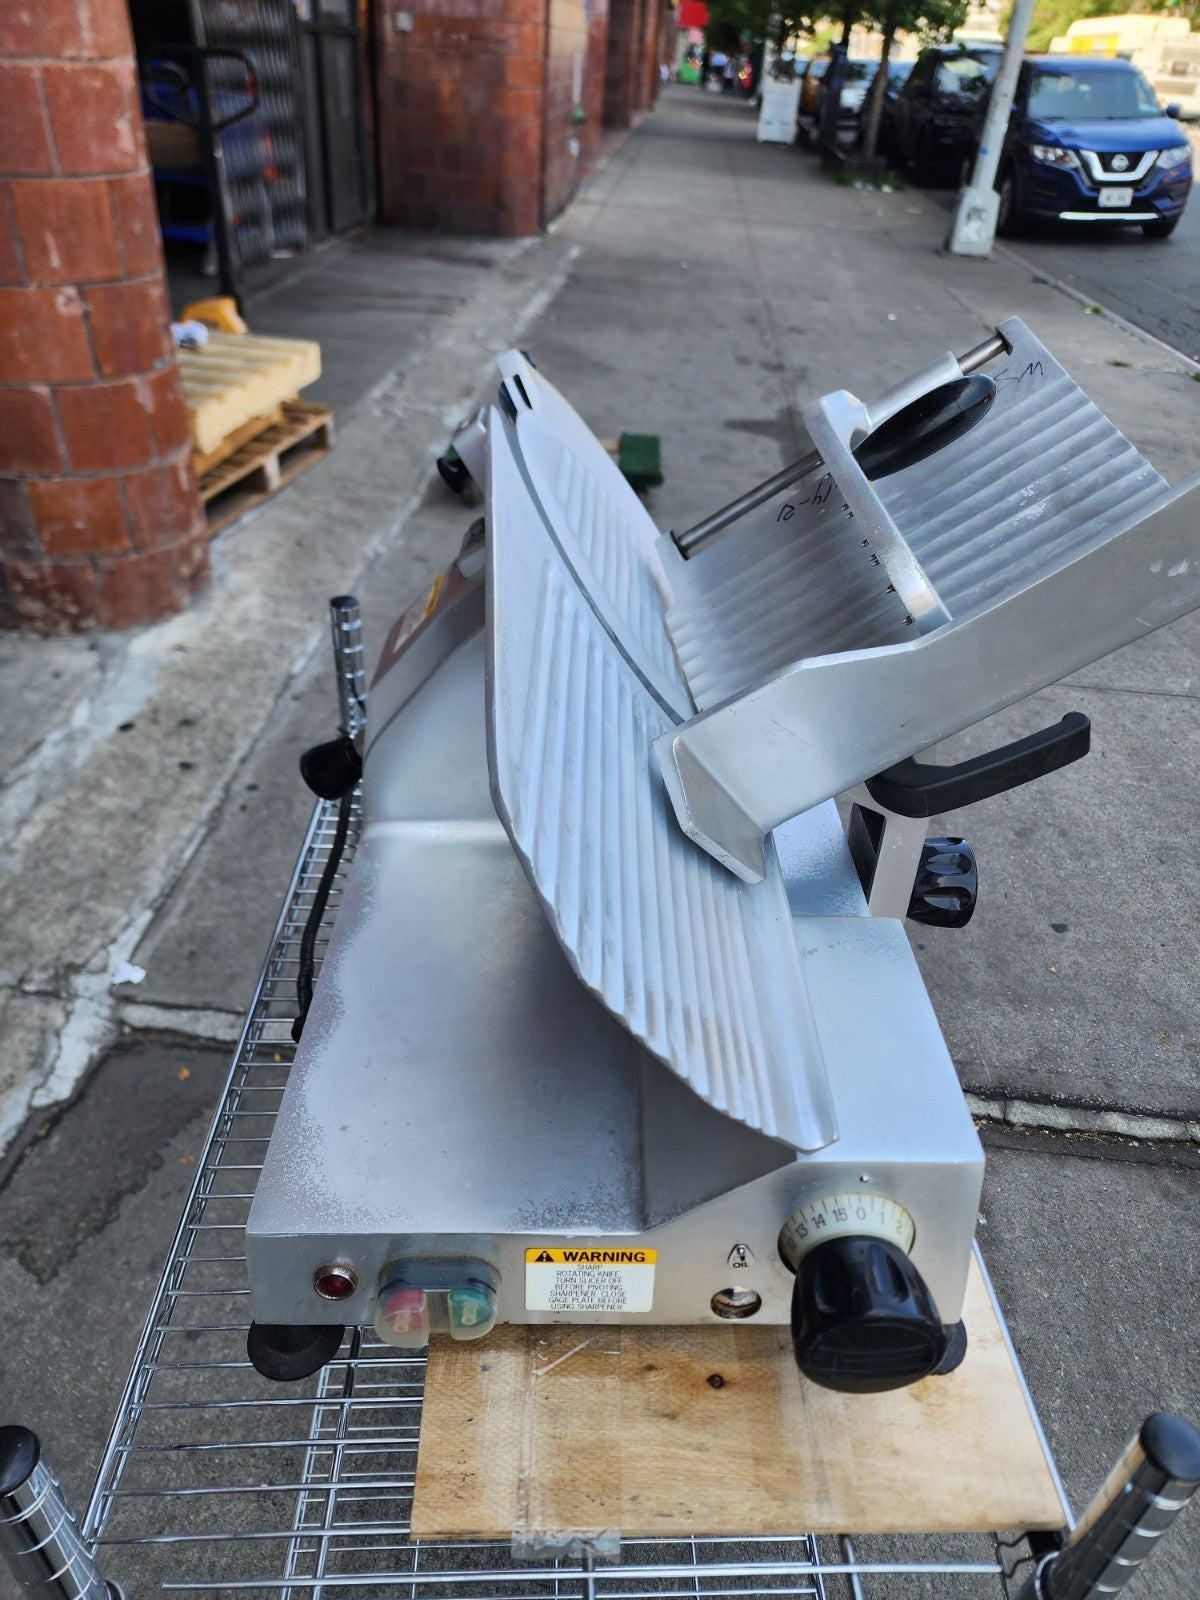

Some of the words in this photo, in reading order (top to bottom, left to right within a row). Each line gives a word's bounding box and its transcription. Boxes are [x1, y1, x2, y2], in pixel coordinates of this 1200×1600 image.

[795, 1223, 809, 1239] 13
[811, 1213, 827, 1229] 14
[832, 1207, 848, 1223] 15
[856, 1207, 866, 1221] 0
[879, 1212, 885, 1225] 1
[895, 1220, 903, 1234] 2
[563, 1251, 645, 1262] WARNING
[732, 1261, 750, 1269] OIL
[554, 1283, 584, 1291] BEFORE
[587, 1284, 623, 1292] PIVOTING
[548, 1296, 569, 1304] GAGE
[597, 1297, 628, 1305] BEFORE
